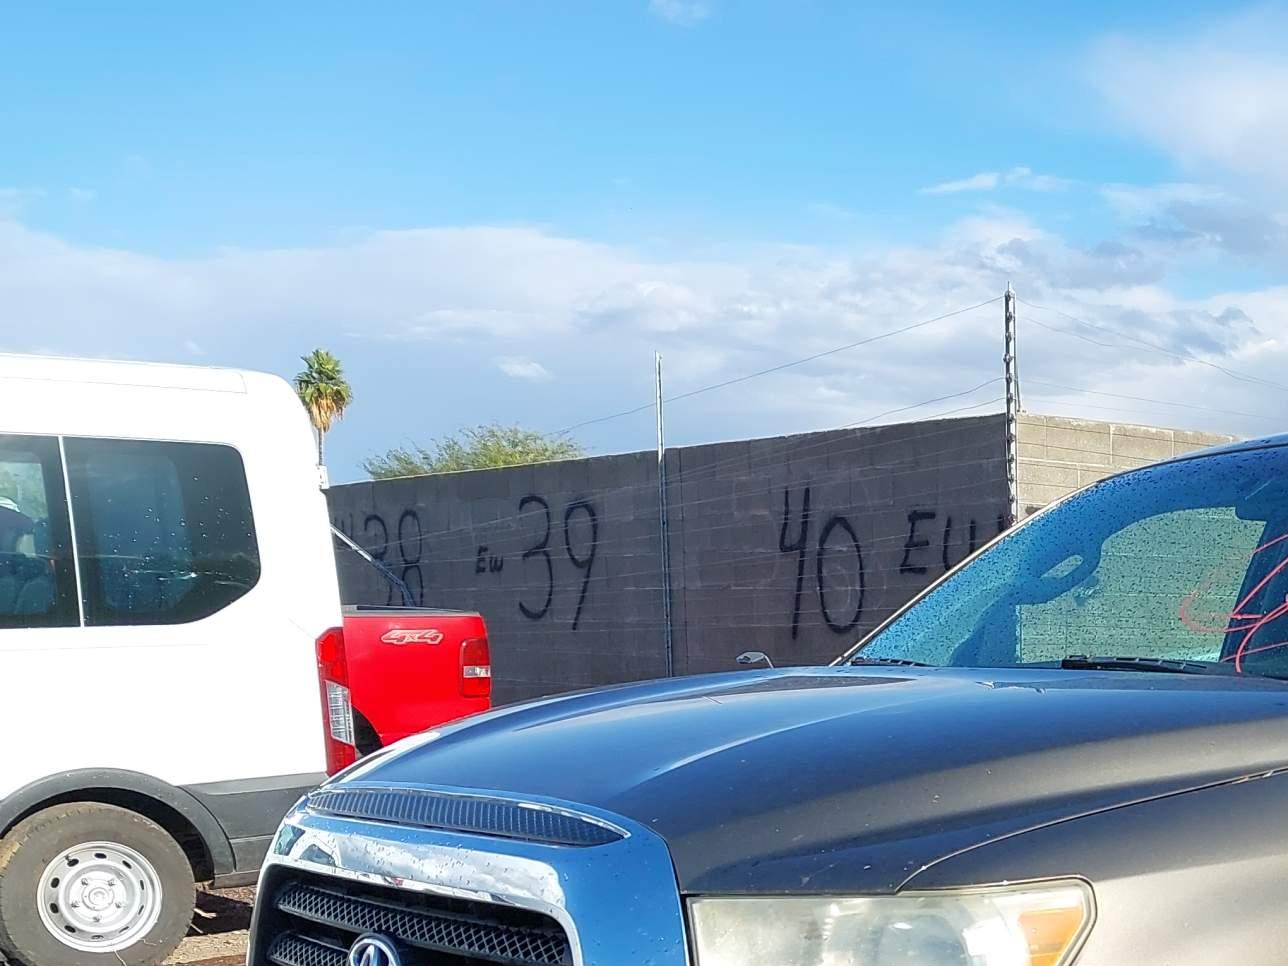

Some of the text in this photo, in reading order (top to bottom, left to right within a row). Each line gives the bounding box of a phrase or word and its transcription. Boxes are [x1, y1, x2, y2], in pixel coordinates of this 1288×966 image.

[517, 494, 599, 631] 39
[779, 485, 865, 641] 40
[380, 629, 444, 645] 4x4
